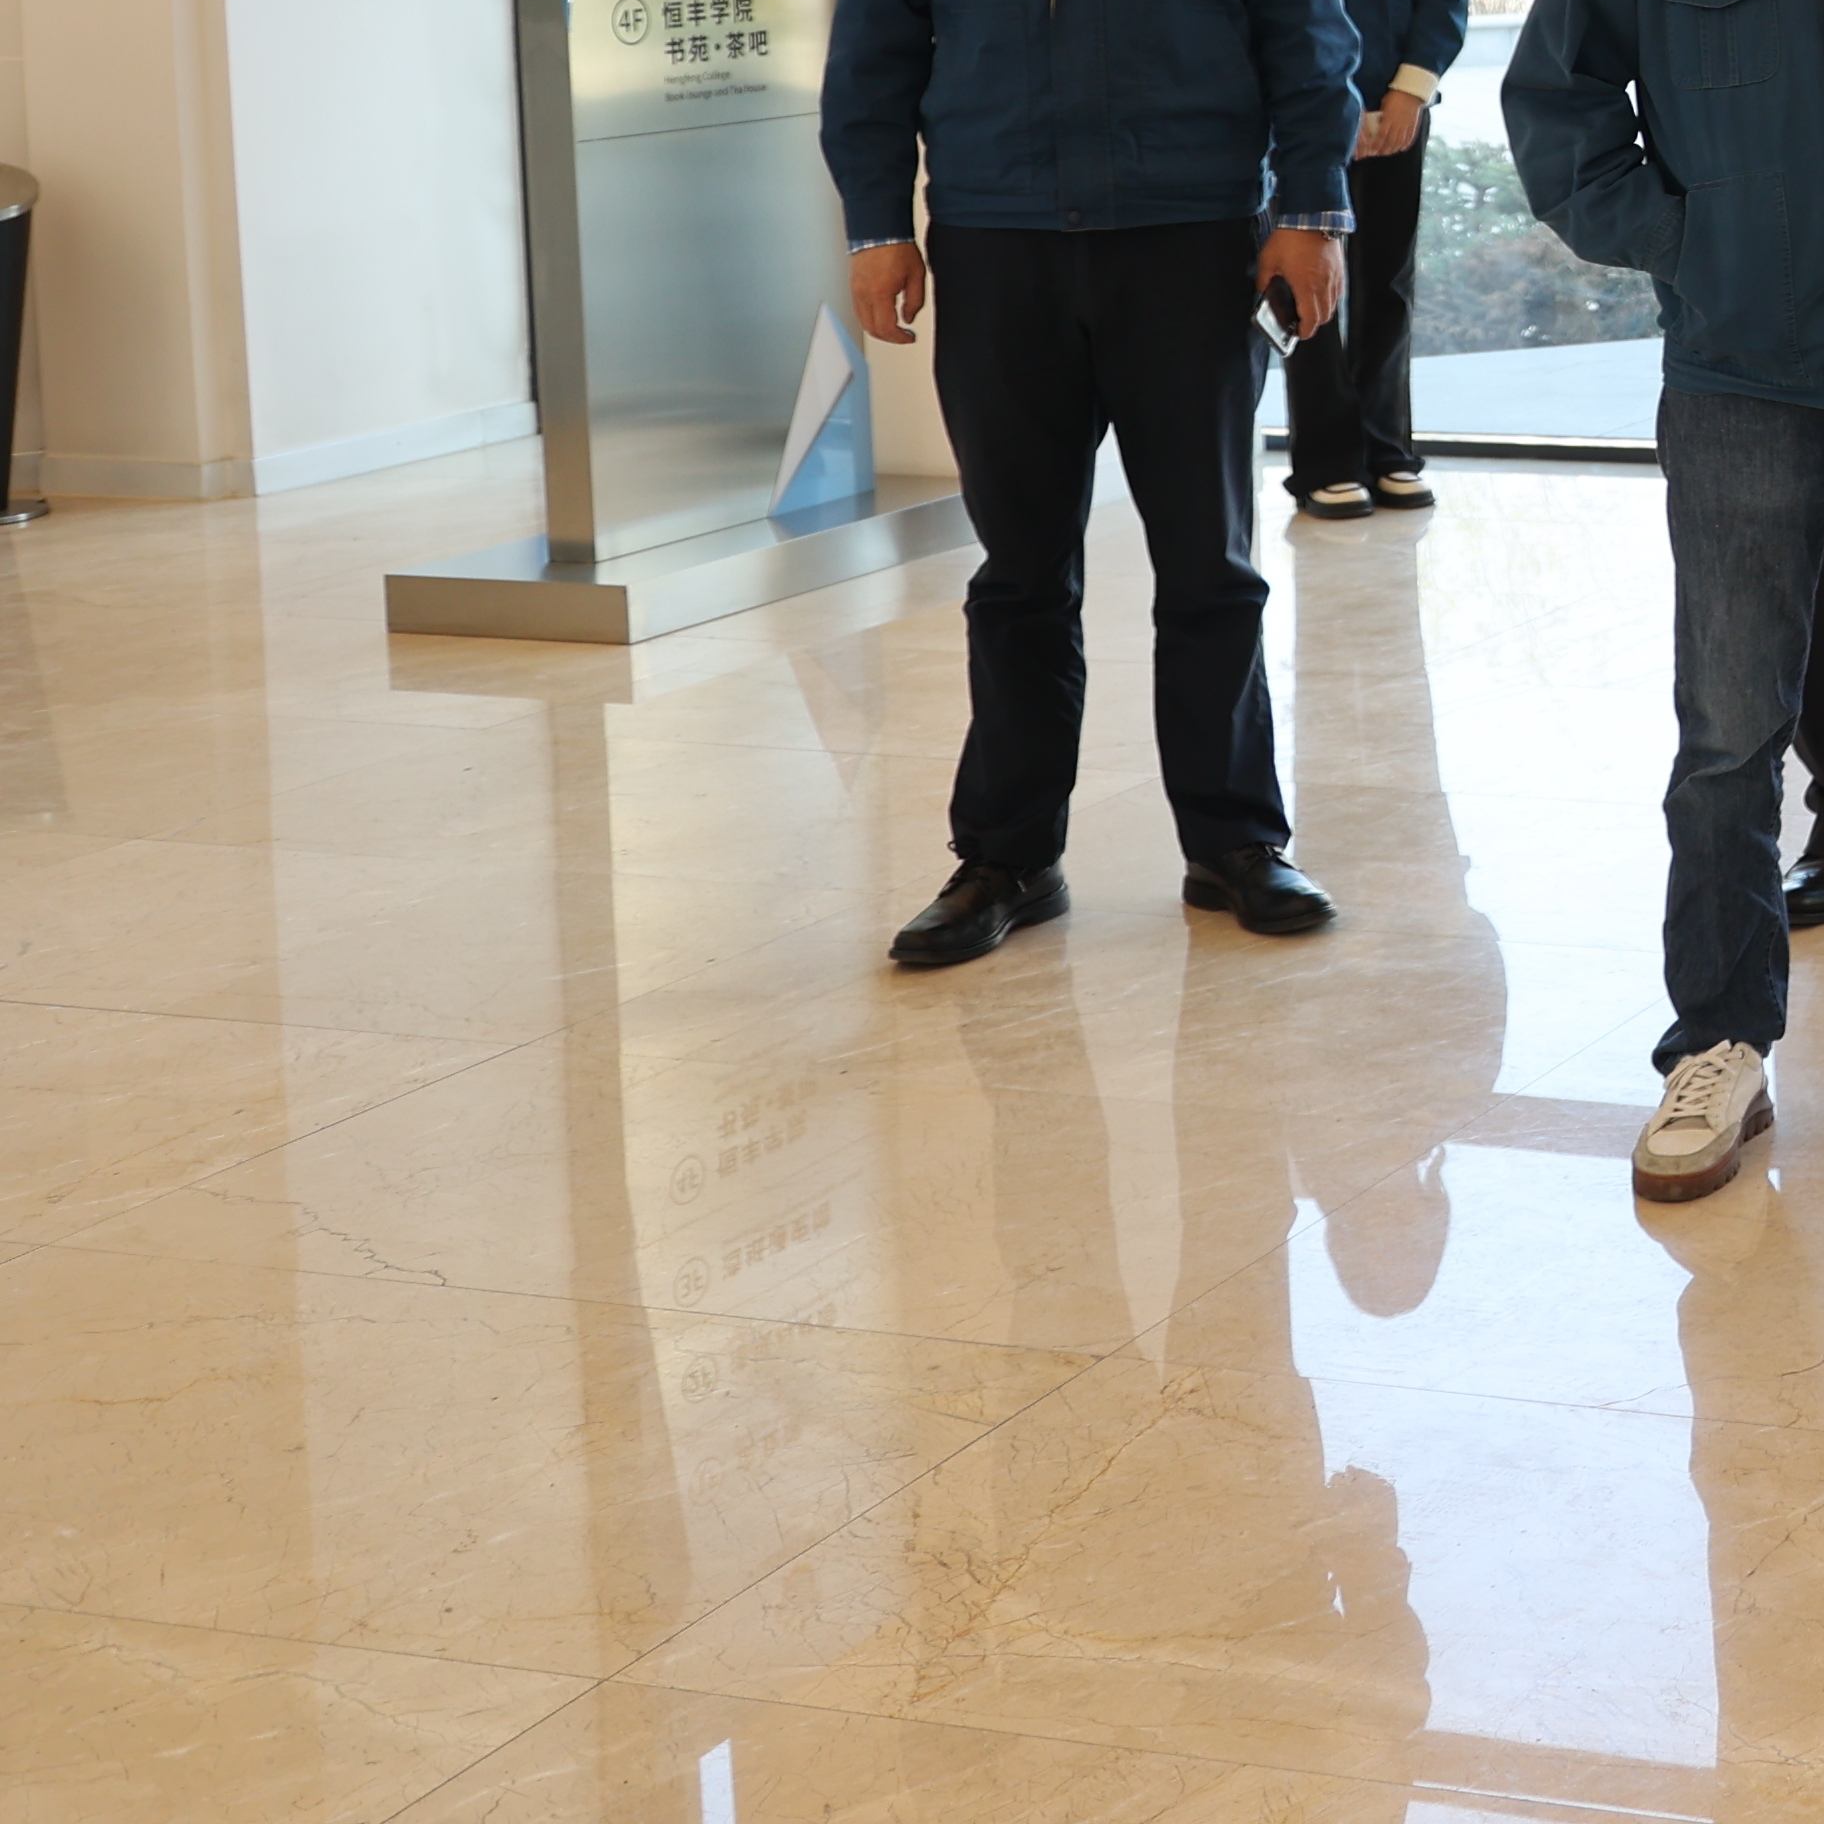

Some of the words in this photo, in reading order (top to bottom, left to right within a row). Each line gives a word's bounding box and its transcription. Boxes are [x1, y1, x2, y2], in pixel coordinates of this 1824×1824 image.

[618, 8, 643, 32] 4F
[664, 31, 768, 65] 书苑·茶吧
